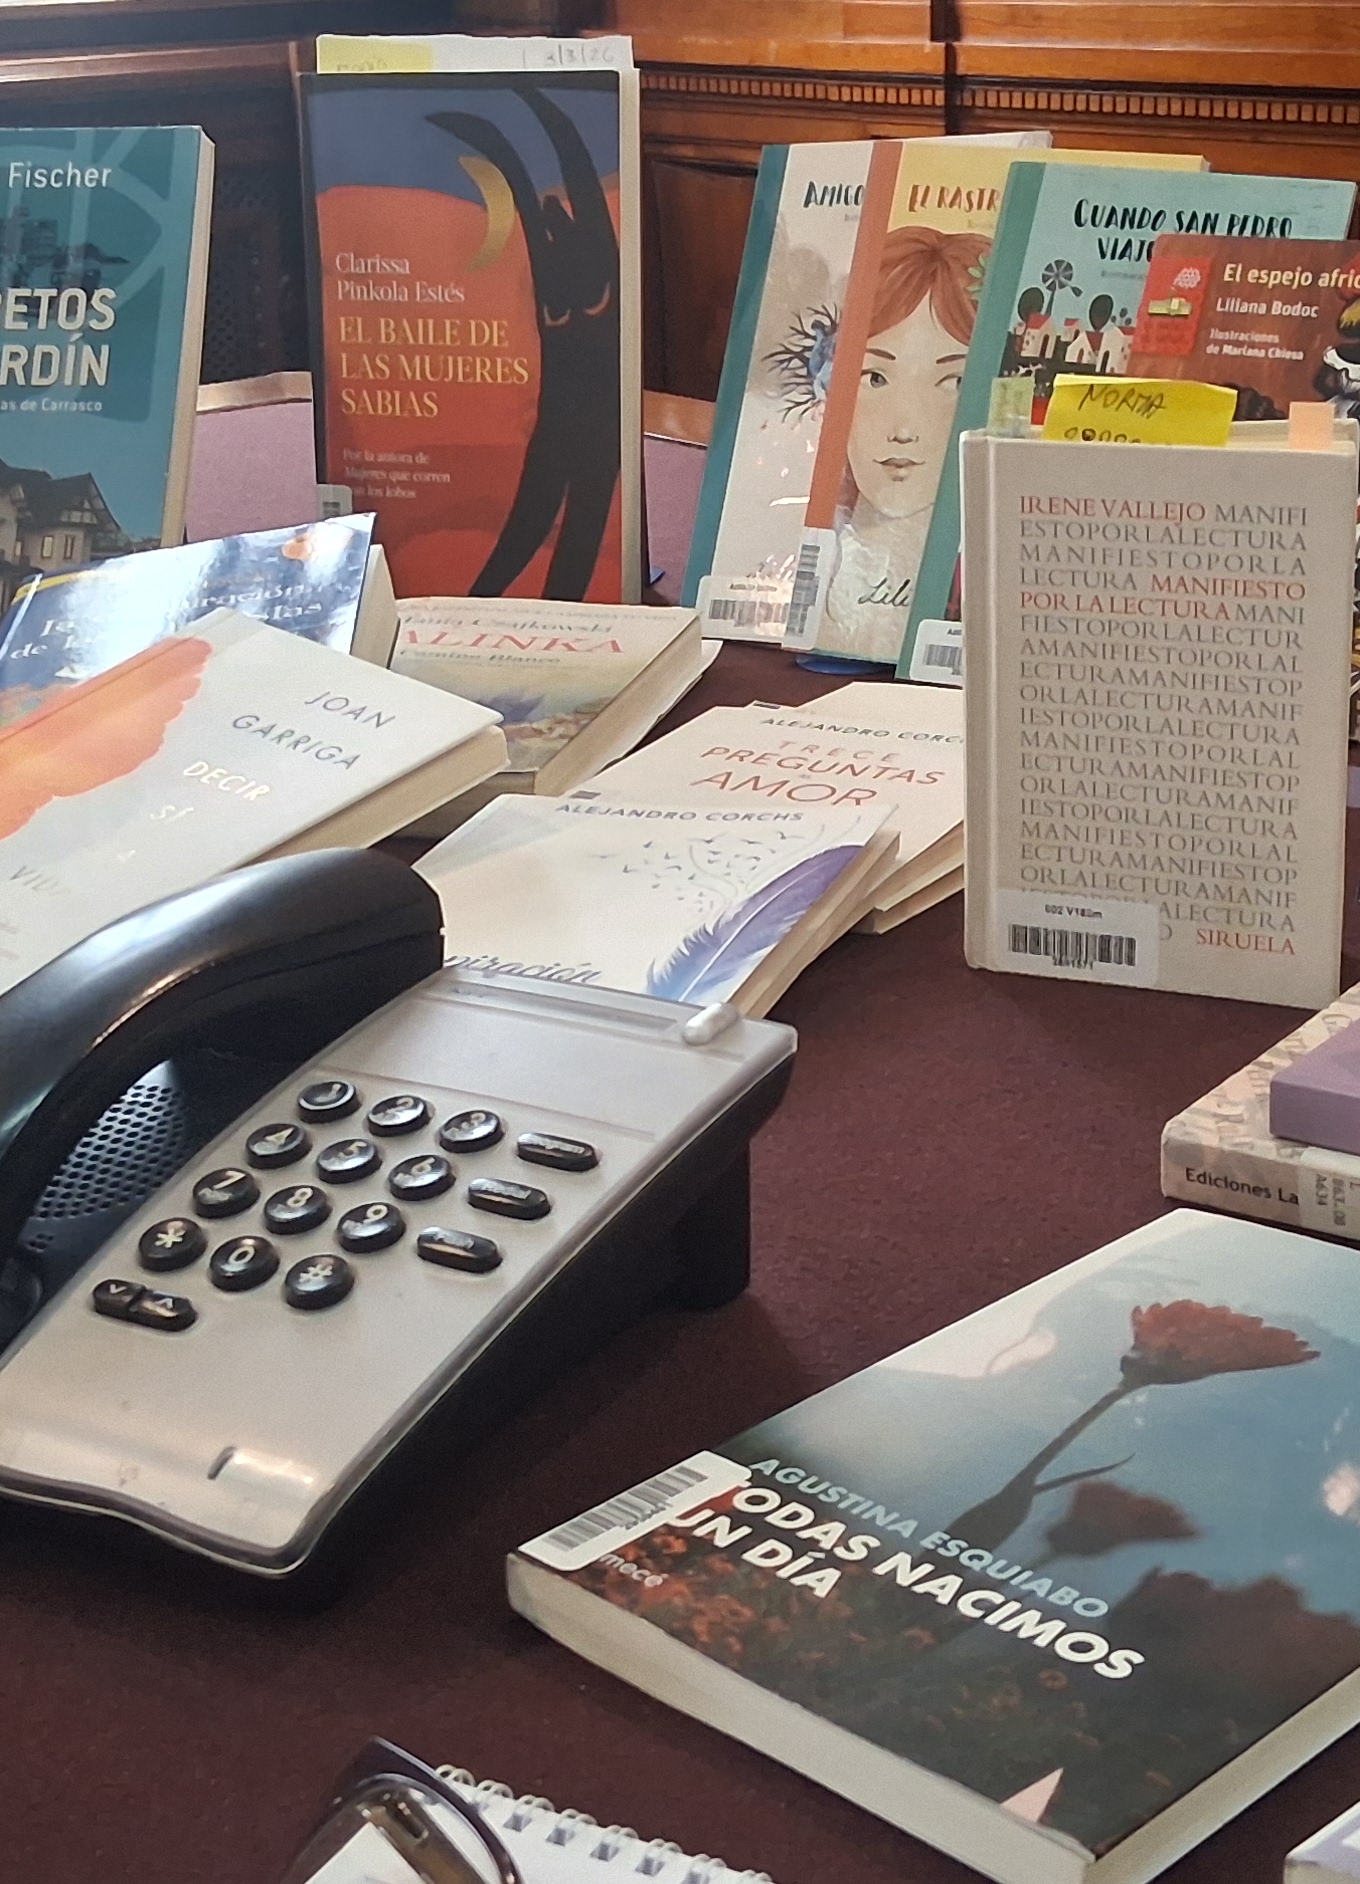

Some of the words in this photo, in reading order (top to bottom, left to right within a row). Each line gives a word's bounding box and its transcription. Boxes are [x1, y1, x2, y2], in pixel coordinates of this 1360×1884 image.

[8, 162, 112, 189] Fischer
[908, 184, 928, 213] EL
[937, 186, 1002, 213] RASTR
[1074, 198, 1166, 233] CUANDO
[1175, 210, 1220, 236] SAN
[1227, 214, 1294, 239] PEDRO
[336, 252, 411, 275] Clarissa
[1224, 263, 1243, 282] El
[1247, 265, 1312, 289] espejo
[338, 280, 408, 303] Pinkola
[416, 281, 465, 303] Estés
[1216, 298, 1267, 315] Liliana
[1271, 300, 1320, 318] Bodoc
[339, 316, 372, 345] EL
[380, 317, 461, 346] BAILE
[469, 319, 509, 349] DE
[1205, 343, 1220, 356] de
[341, 352, 390, 381] LAS
[398, 354, 530, 385] MUJERES
[20, 398, 38, 411] de
[42, 399, 103, 412] Carrasco
[341, 389, 440, 418] SABIAS
[1020, 496, 1094, 518] IRENE
[1101, 499, 1206, 525] VALLEJO
[1215, 503, 1307, 527] MANIFI
[1020, 567, 1138, 592] LECTURA
[1150, 573, 1307, 601] MANIFIESTO
[1020, 591, 1070, 612] POR
[1110, 595, 1230, 622] LECTURA
[1235, 603, 1305, 625] MANI
[305, 689, 397, 731] JOAN
[231, 713, 363, 771] GARRIGA
[759, 717, 890, 739] ALEJANDRO
[700, 746, 946, 787] PREGUNTAS
[777, 739, 900, 763] TRECE
[183, 760, 275, 801] DECIR
[690, 770, 879, 809] AMOR
[554, 802, 697, 823] ALEJANDRO
[705, 809, 804, 824] CORCHS
[1197, 928, 1297, 955] SIRUELA
[212, 1170, 246, 1190] 7
[286, 1187, 315, 1209] 8
[361, 1204, 389, 1225] 9
[1185, 1166, 1275, 1204] Ediciones
[227, 1244, 255, 1265] 0
[665, 1508, 753, 1549] UN
[741, 1536, 843, 1600] DÍA
[748, 1458, 919, 1540] AGUSTINA
[920, 1529, 1109, 1621] ESQUIABO
[874, 1551, 1146, 1682] NACIMOS
